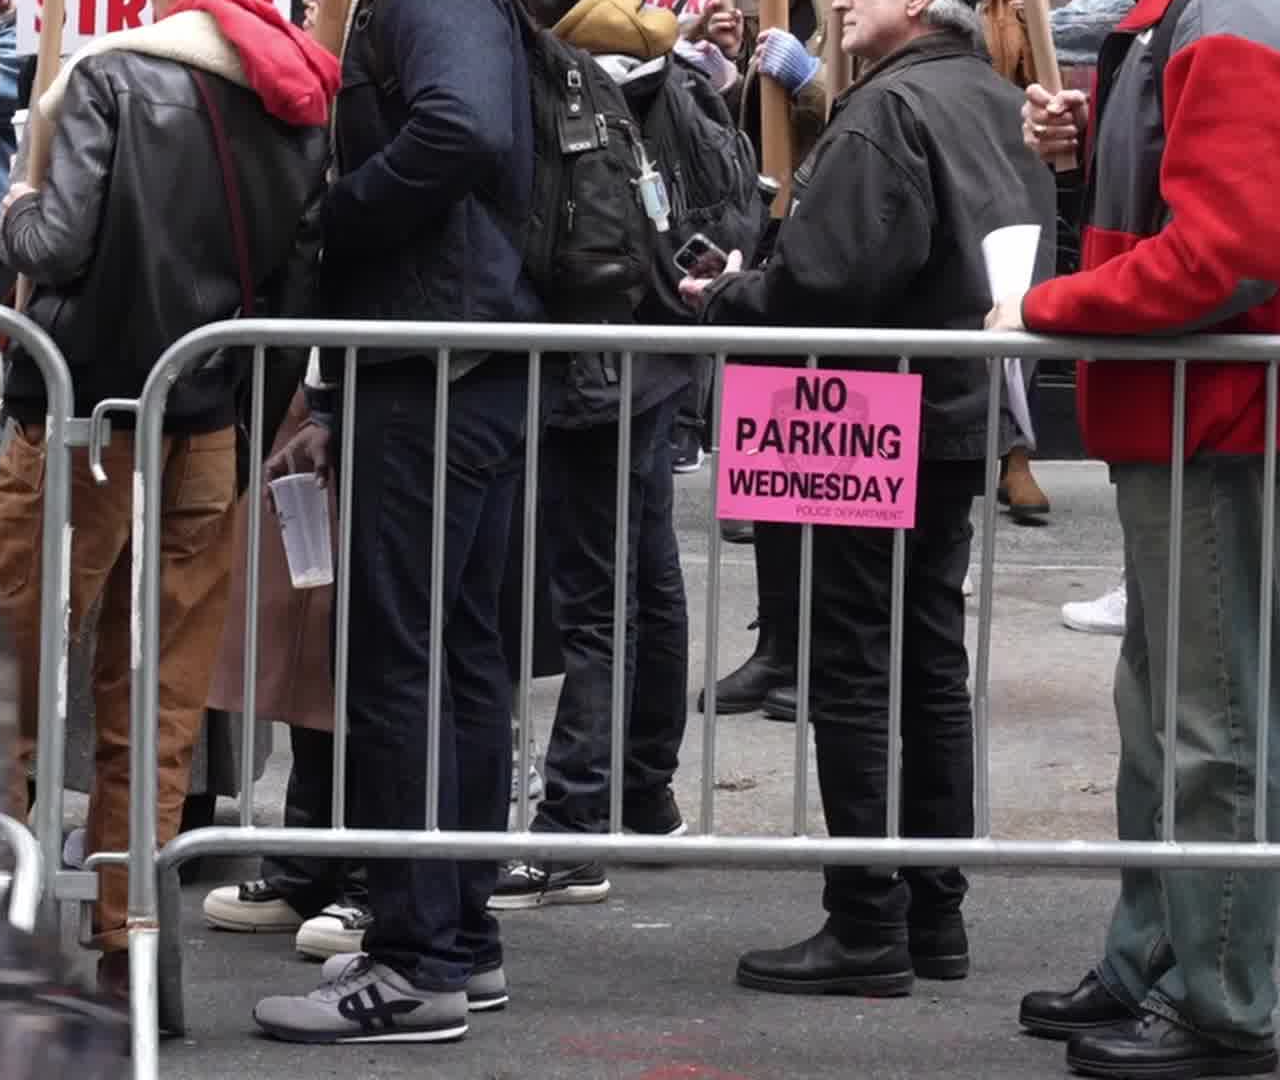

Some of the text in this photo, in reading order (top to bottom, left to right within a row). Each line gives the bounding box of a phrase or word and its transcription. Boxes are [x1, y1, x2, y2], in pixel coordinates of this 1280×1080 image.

[795, 376, 848, 413] NO
[736, 416, 902, 460] PARKING
[728, 468, 905, 504] WEDNESDAY
[796, 505, 905, 521] POLICE DEPARTMENT
